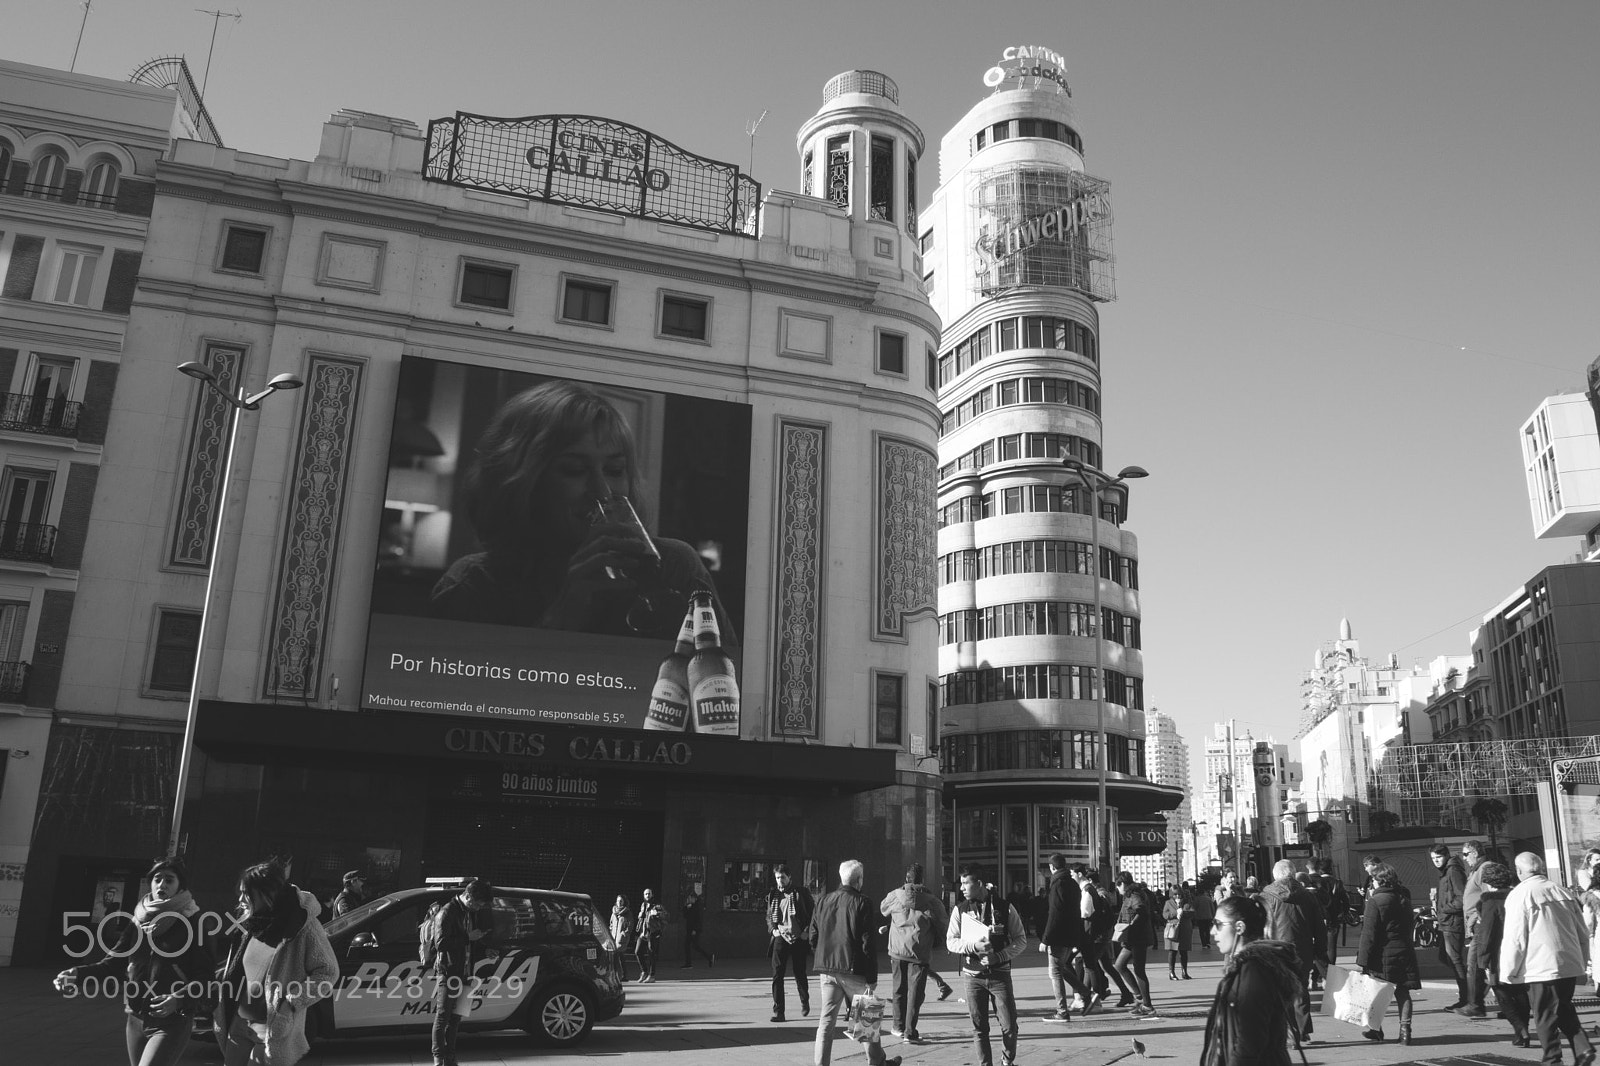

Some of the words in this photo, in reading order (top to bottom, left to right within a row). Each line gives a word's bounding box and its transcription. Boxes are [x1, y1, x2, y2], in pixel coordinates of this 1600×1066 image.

[1003, 45, 1067, 72] CAPITOL
[558, 130, 644, 162] CINES
[526, 146, 670, 192] CALLAO
[975, 189, 1112, 278] Schweppes
[390, 653, 424, 672] Por
[430, 657, 511, 680] historias
[517, 668, 569, 685] como
[575, 671, 637, 690] estas...
[368, 694, 407, 707] Mahou
[410, 698, 473, 712] recomienda
[476, 703, 486, 713] el
[488, 705, 536, 717] consumo
[538, 708, 600, 722] responsable
[445, 728, 546, 757] CINES
[569, 736, 692, 765] CALLAO
[502, 772, 519, 790] 90
[521, 773, 553, 792] años
[556, 775, 598, 794] juntos
[573, 915, 590, 926] 112
[353, 950, 541, 989] POLCÍA
[400, 997, 483, 1016] MAD
